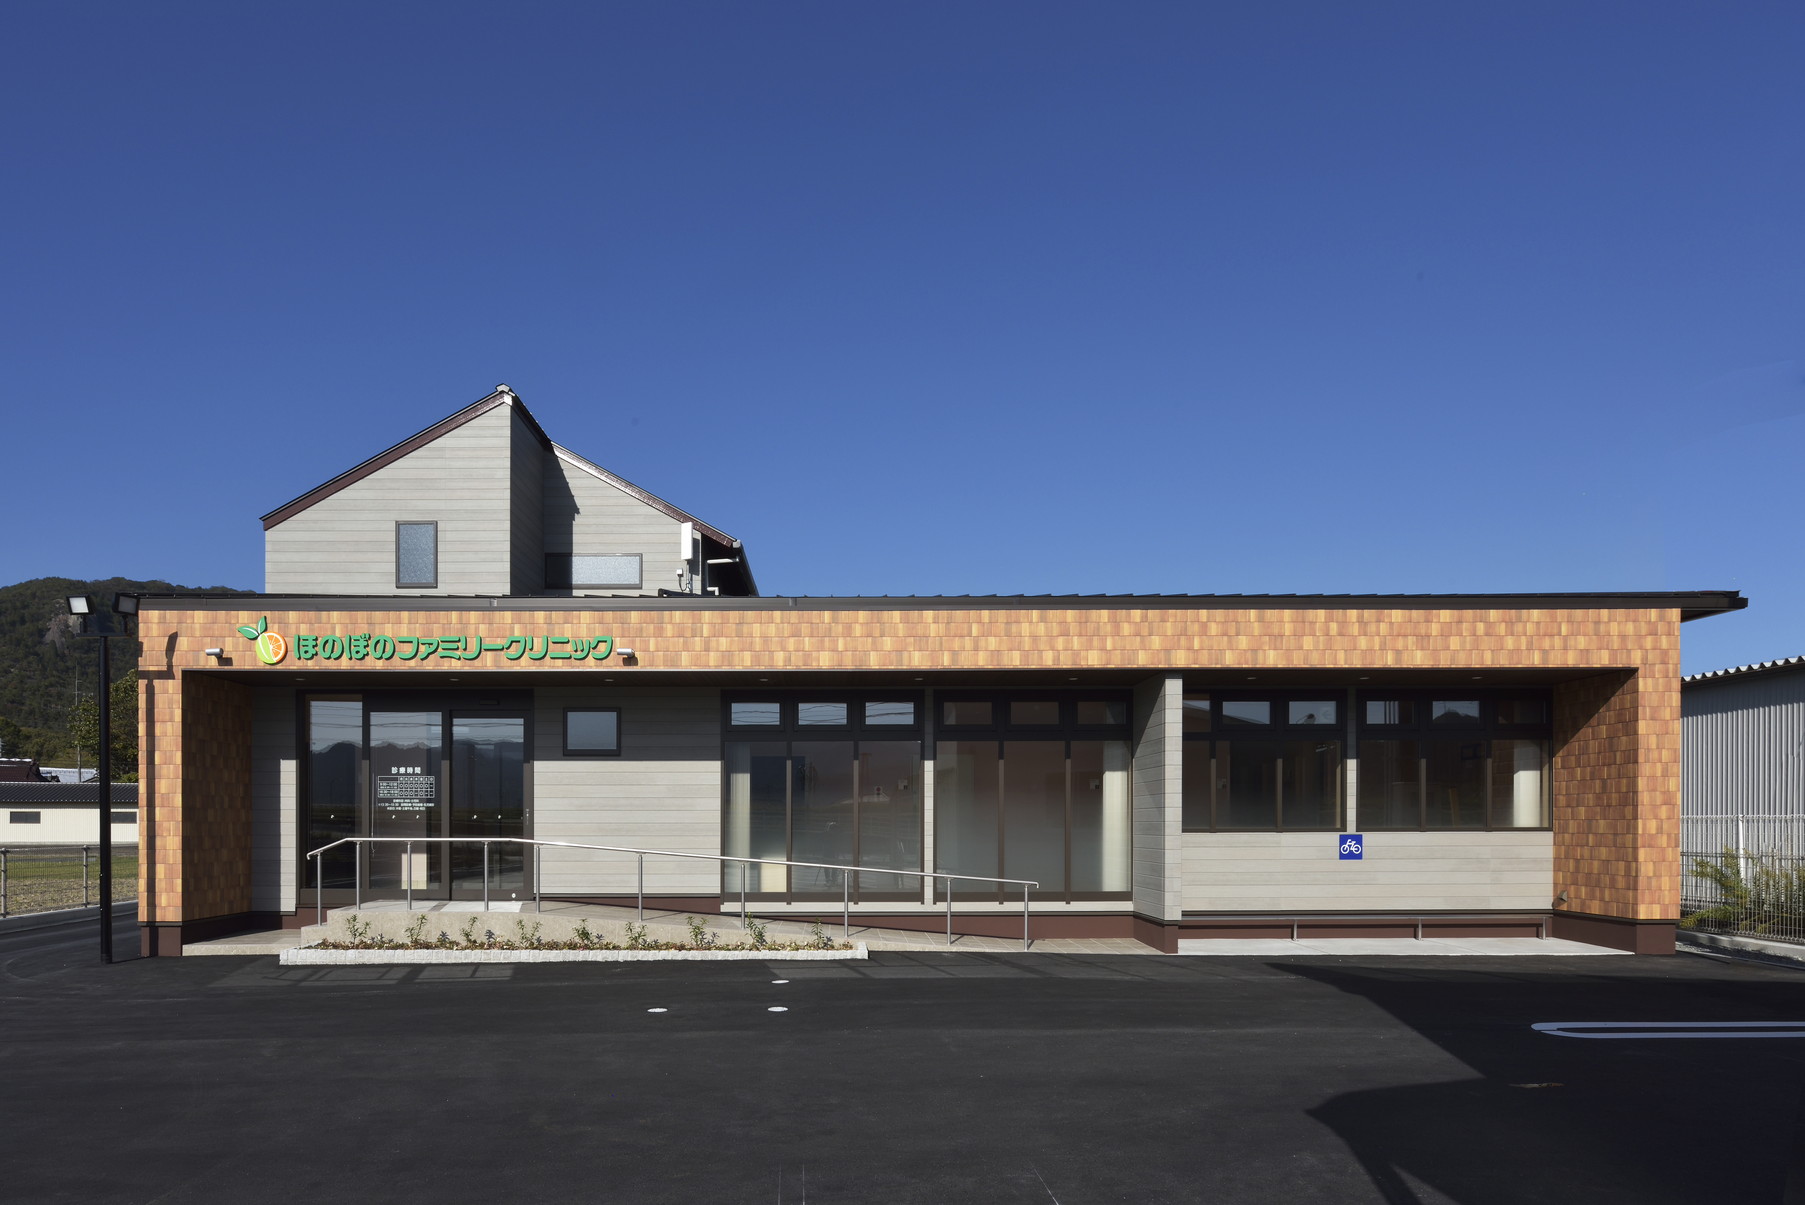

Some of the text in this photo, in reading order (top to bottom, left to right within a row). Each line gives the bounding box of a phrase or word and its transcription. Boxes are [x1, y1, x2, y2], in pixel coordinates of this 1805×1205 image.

[293, 633, 613, 660] ほのぼのファミリークリニック
